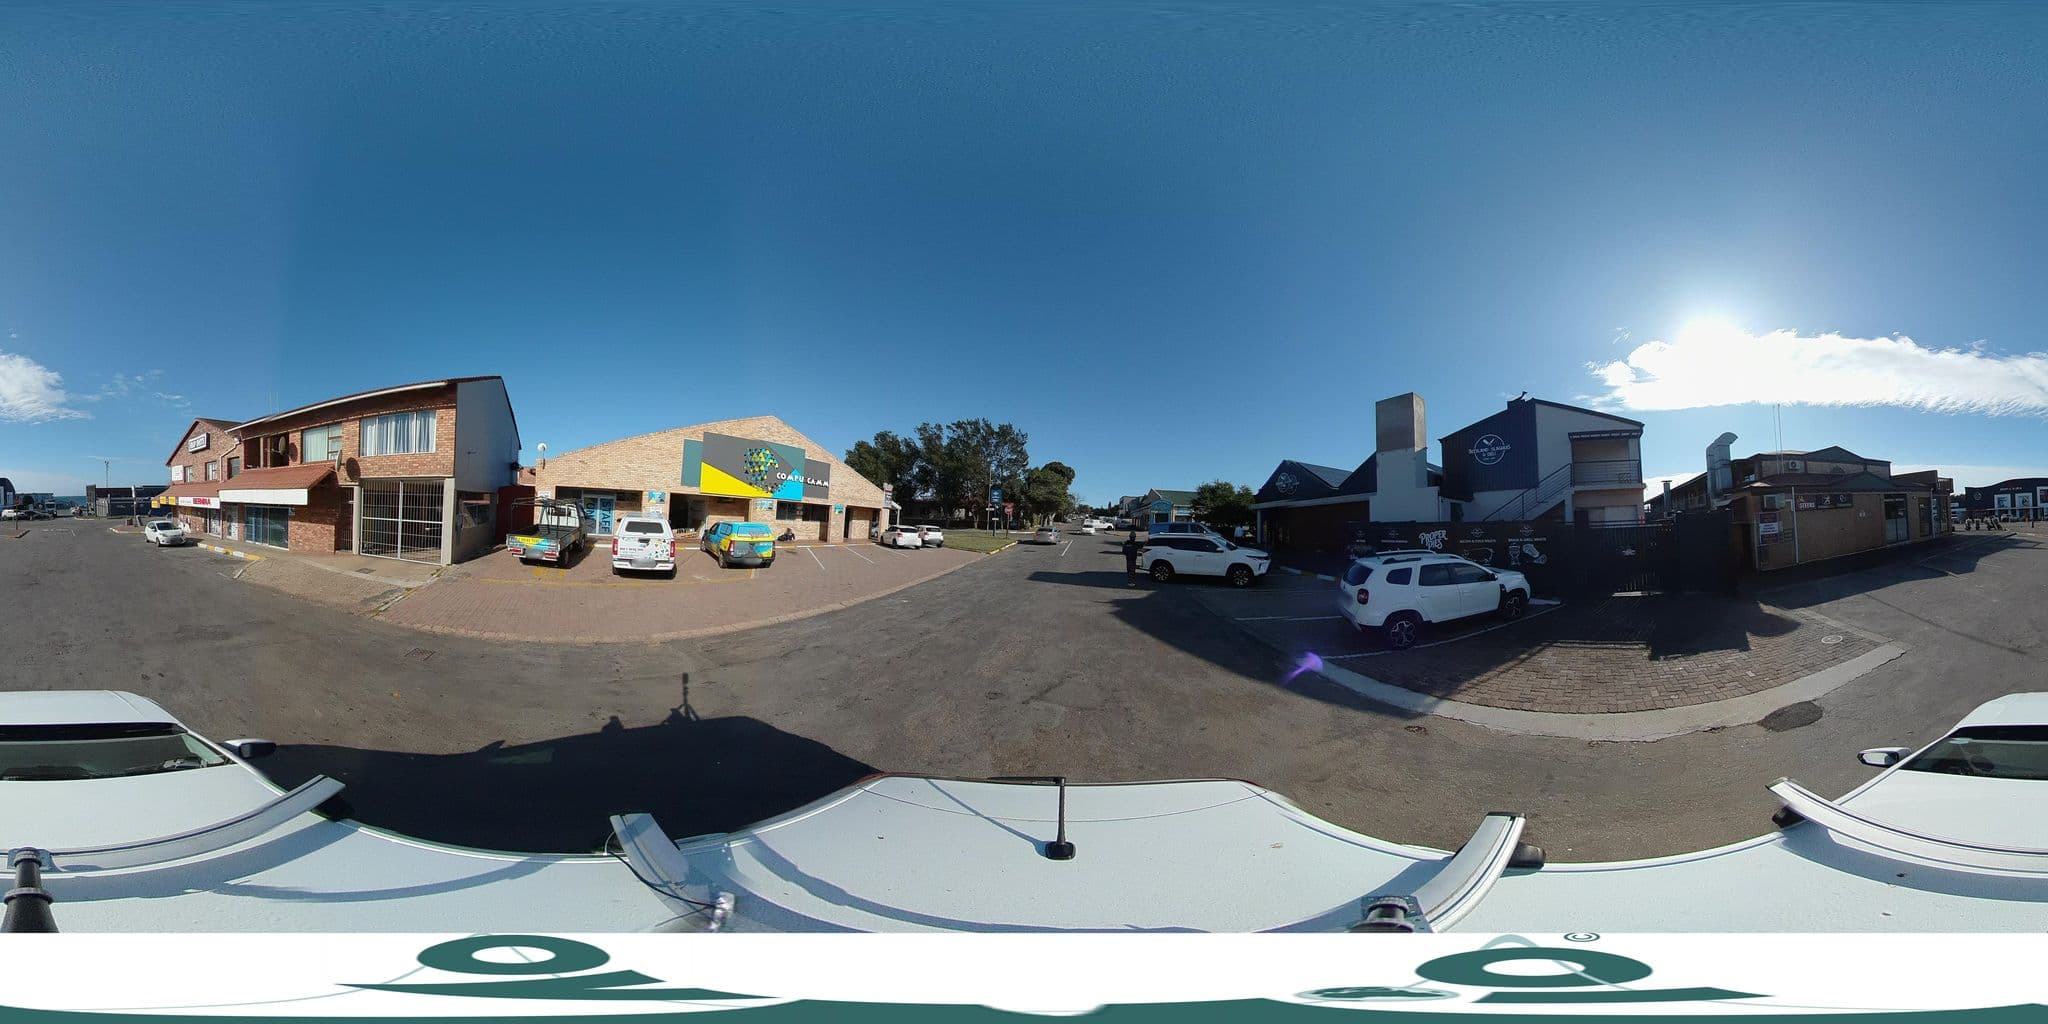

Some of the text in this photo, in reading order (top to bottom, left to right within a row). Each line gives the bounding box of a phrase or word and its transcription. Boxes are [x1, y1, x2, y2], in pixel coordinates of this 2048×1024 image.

[776, 472, 829, 487] COMPU CAMM
[602, 501, 611, 533] STAFF
[1418, 530, 1449, 546] PROPER
[1427, 538, 1443, 551] PIES
